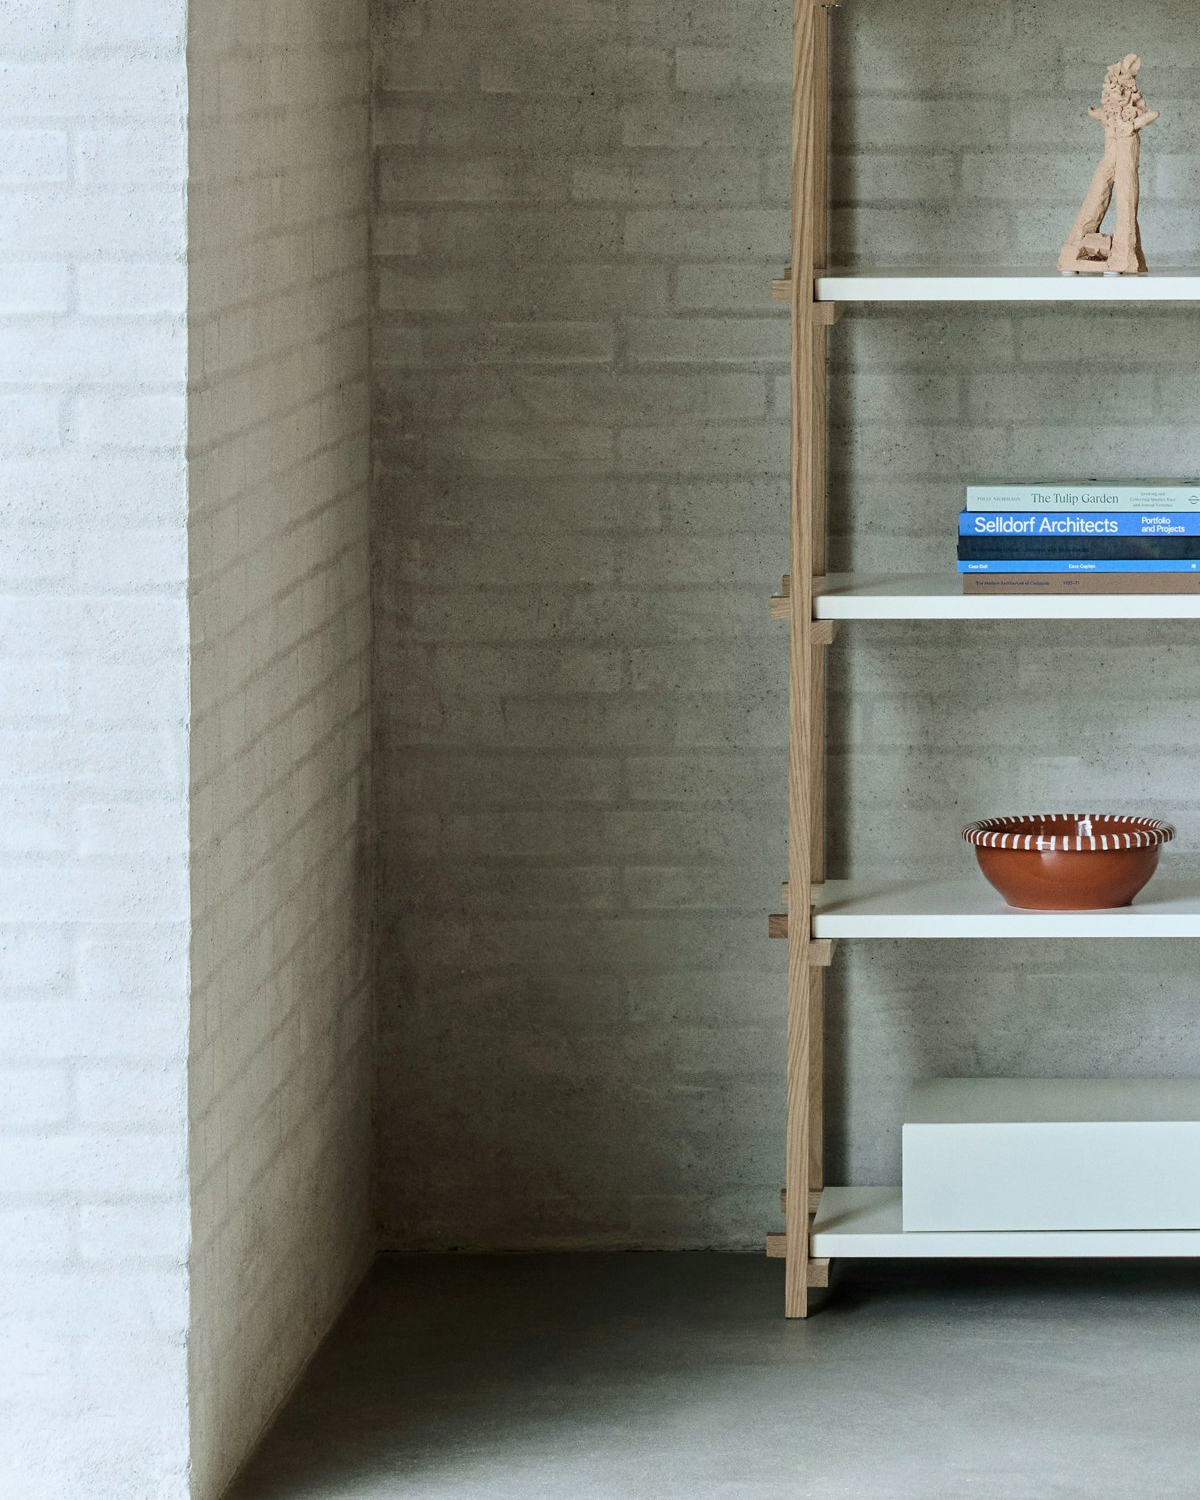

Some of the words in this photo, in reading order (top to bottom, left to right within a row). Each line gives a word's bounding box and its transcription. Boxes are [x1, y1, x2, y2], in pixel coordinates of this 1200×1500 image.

[1031, 493, 1050, 504] The
[1053, 493, 1079, 506] Tulip
[1081, 493, 1119, 504] Garden
[974, 516, 1036, 533] Selldorf
[1039, 516, 1119, 533] Architects
[1141, 516, 1171, 525] Portfolio
[1141, 525, 1155, 533] and
[1156, 525, 1186, 534] Projects
